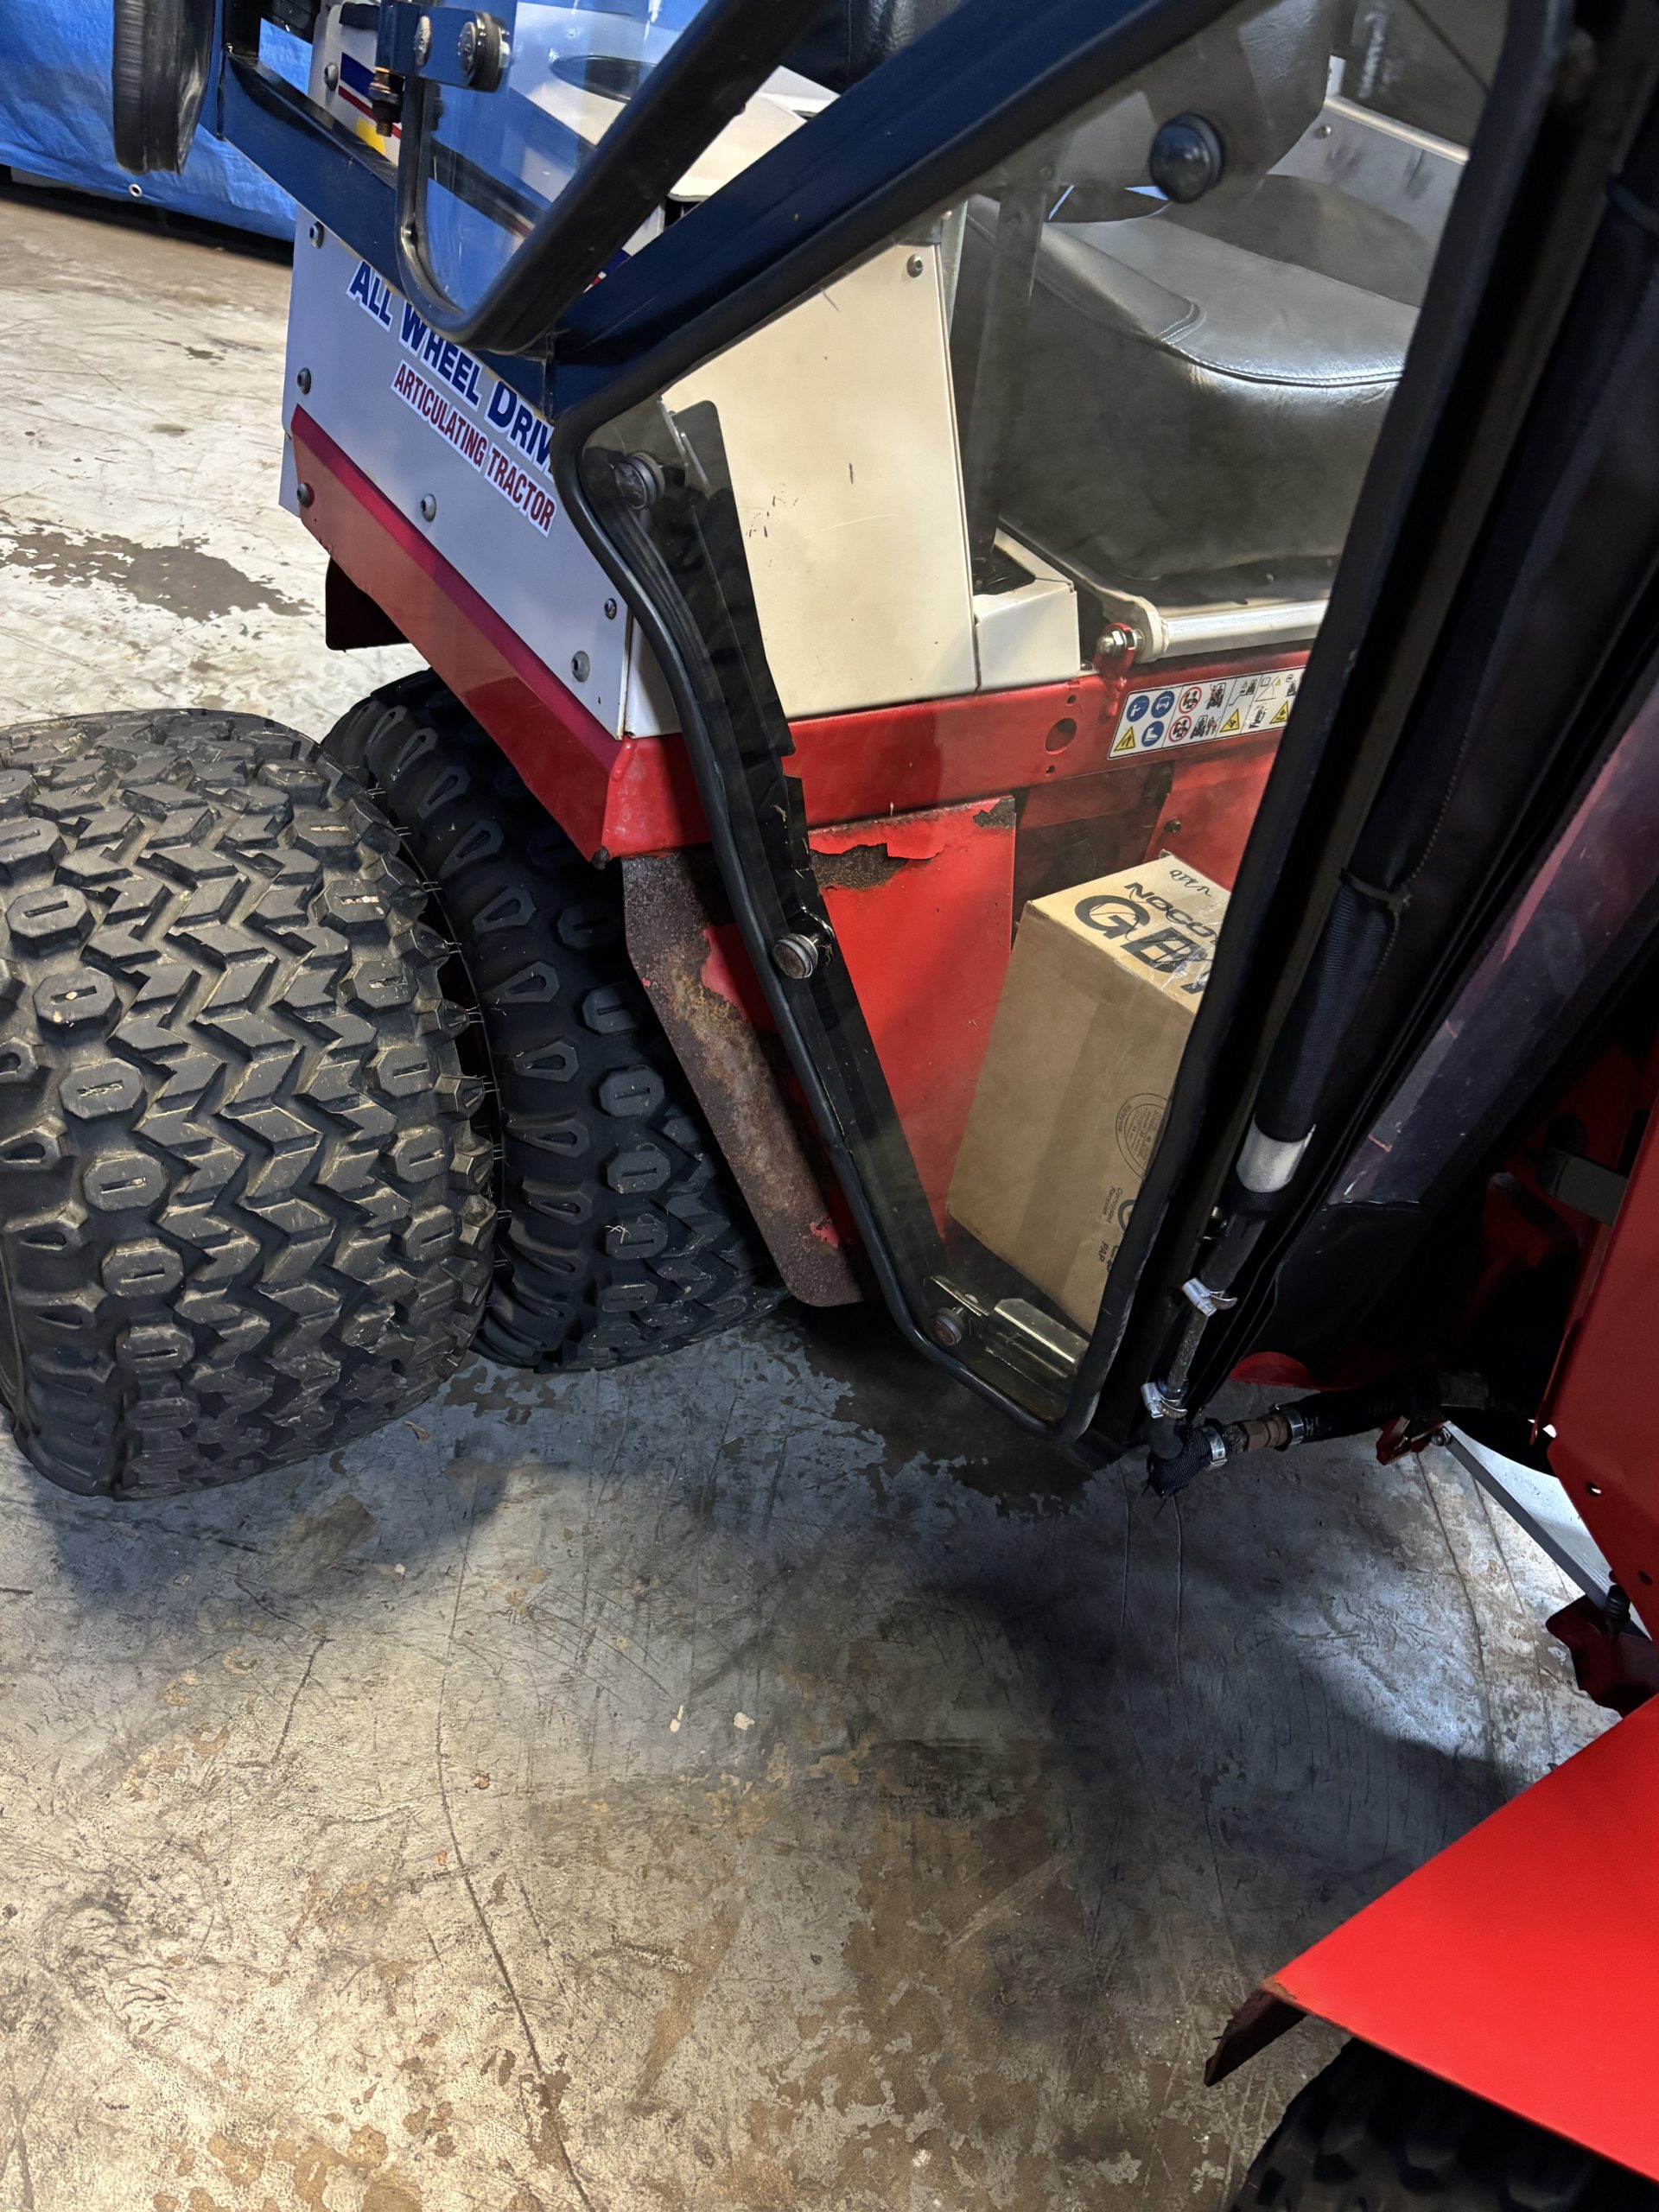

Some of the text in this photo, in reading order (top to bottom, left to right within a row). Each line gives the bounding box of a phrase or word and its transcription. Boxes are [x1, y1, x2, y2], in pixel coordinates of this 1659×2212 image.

[349, 260, 553, 474] ALL WHEEL DRIV
[394, 363, 556, 531] ARTICULATING TRACTOR
[1124, 882, 1217, 938] NOCO
[1098, 1241, 1109, 1262] PAP
